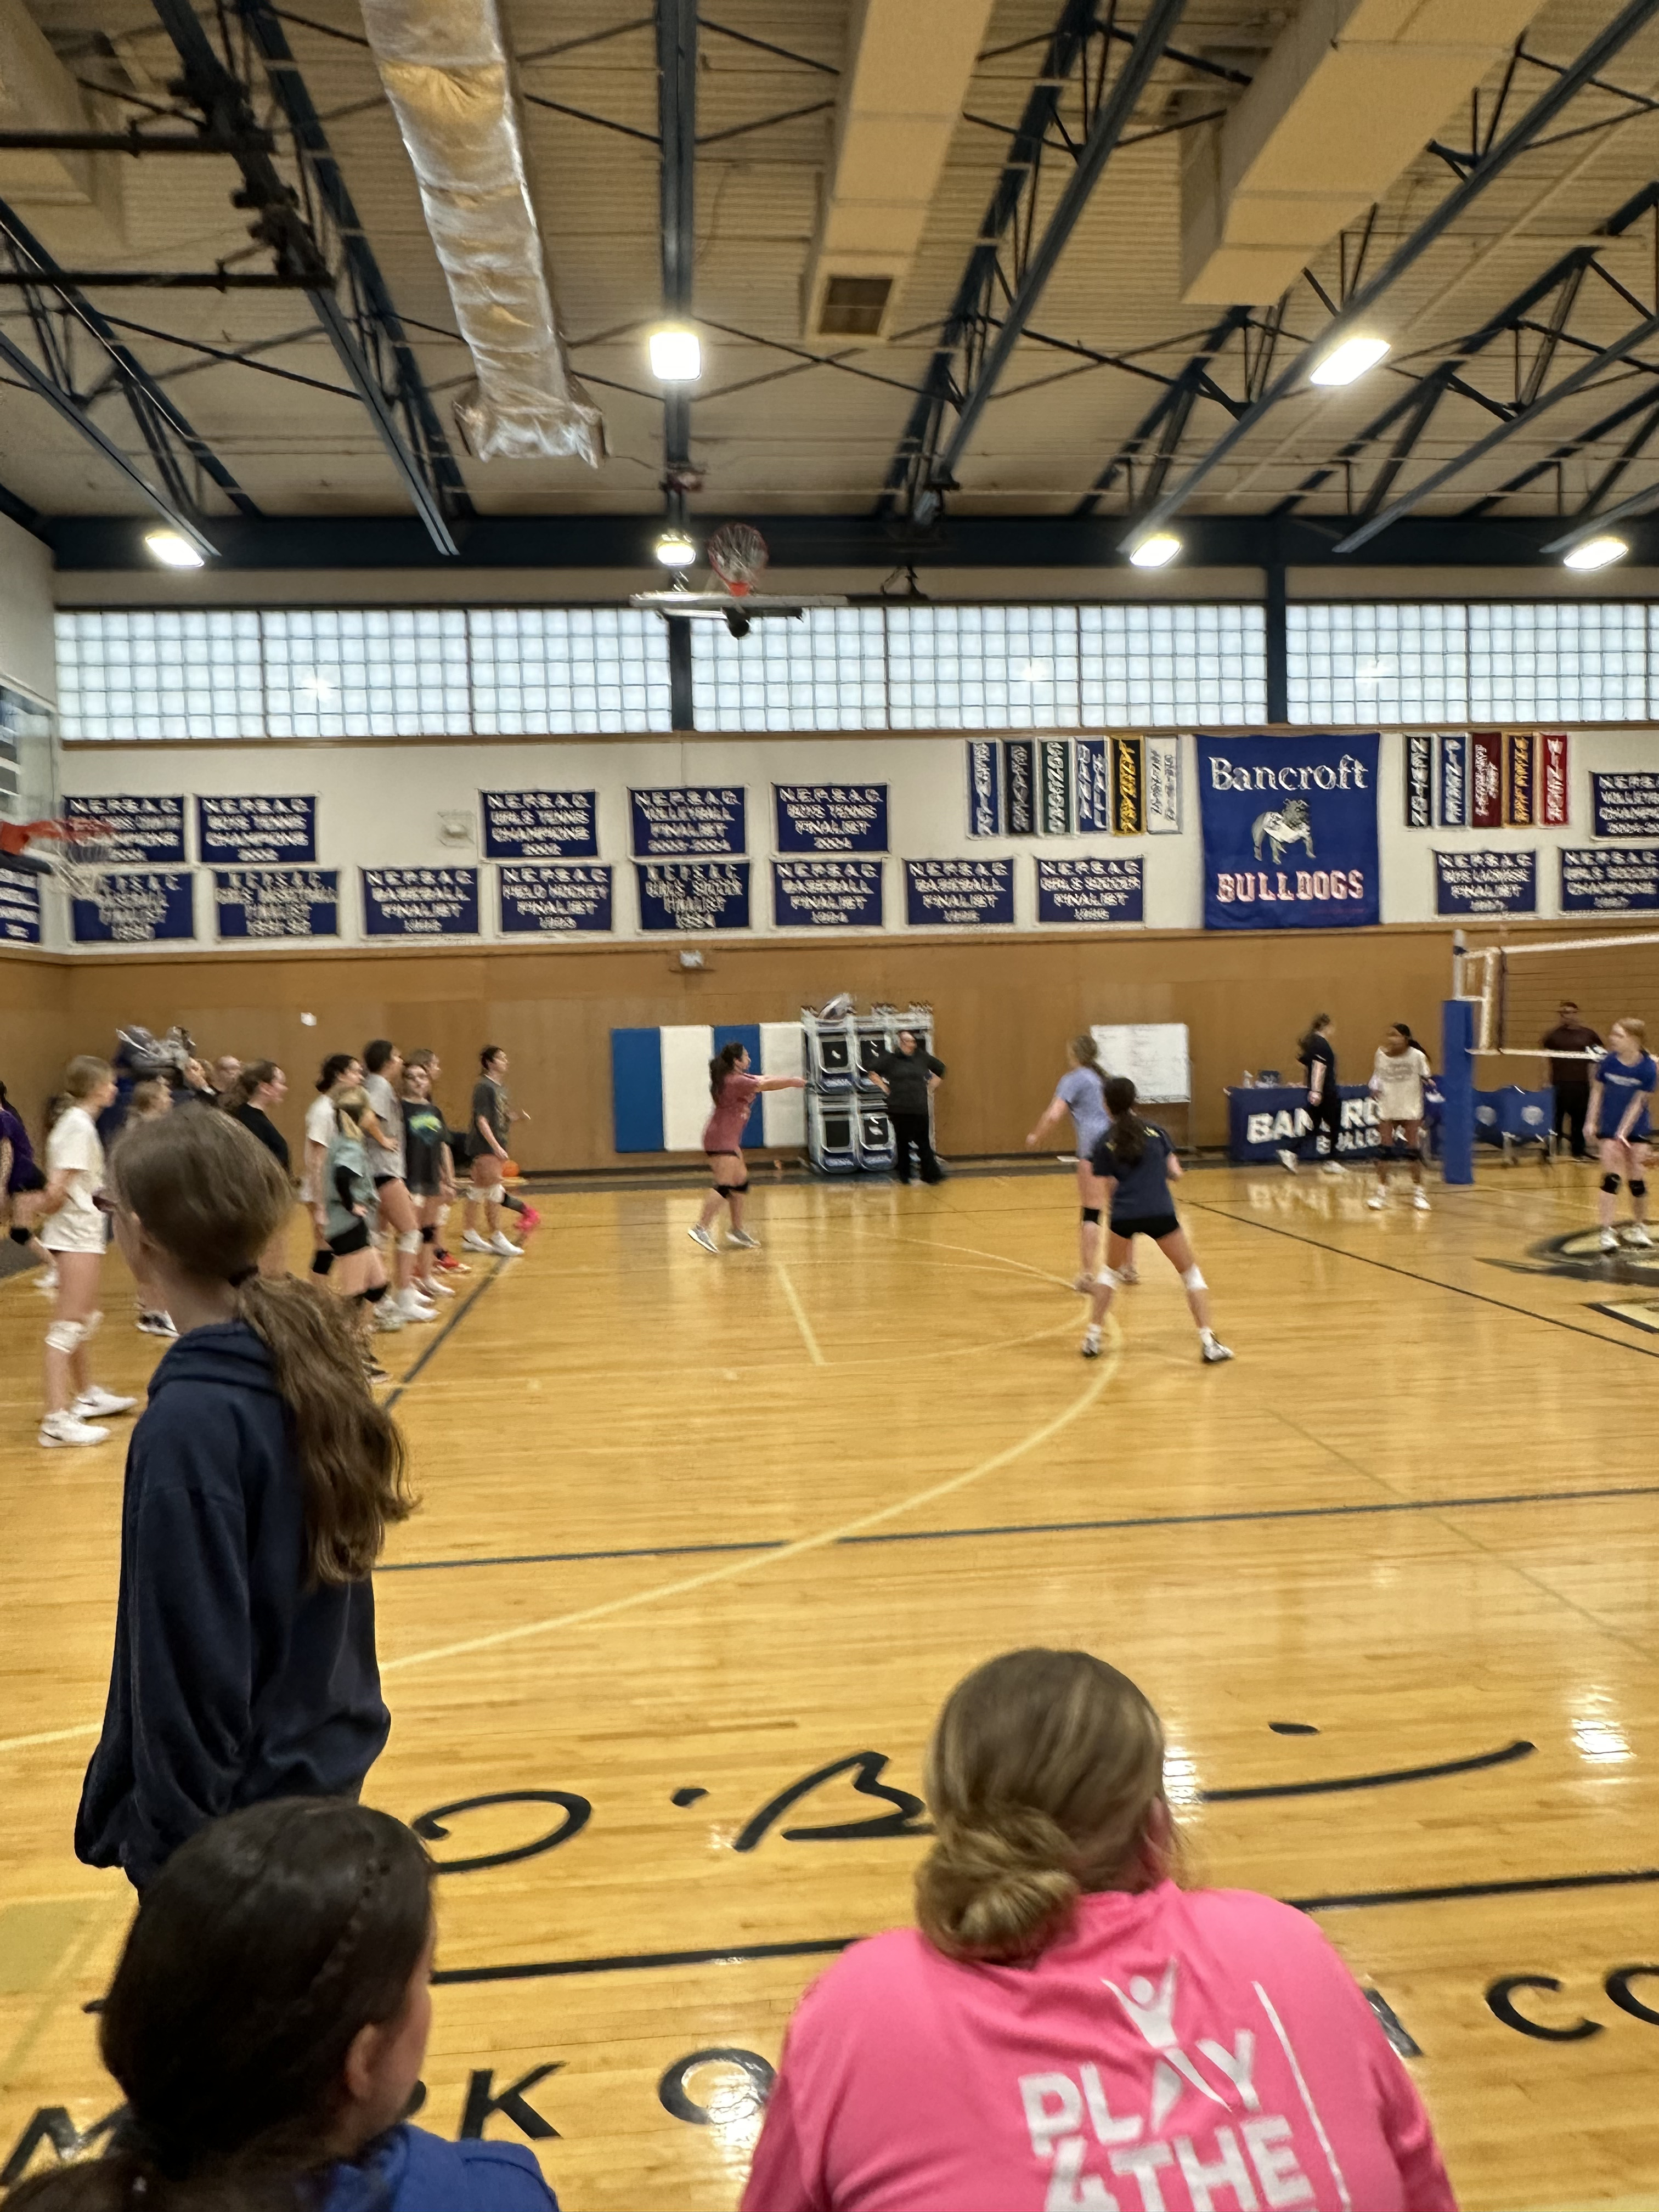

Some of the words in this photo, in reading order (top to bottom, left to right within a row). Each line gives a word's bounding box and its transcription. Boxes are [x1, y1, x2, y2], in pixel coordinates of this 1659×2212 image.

[1208, 754, 1369, 791] Bancroft
[1216, 869, 1364, 904] BULLDOGS
[1018, 2028, 1261, 2157] PLAY
